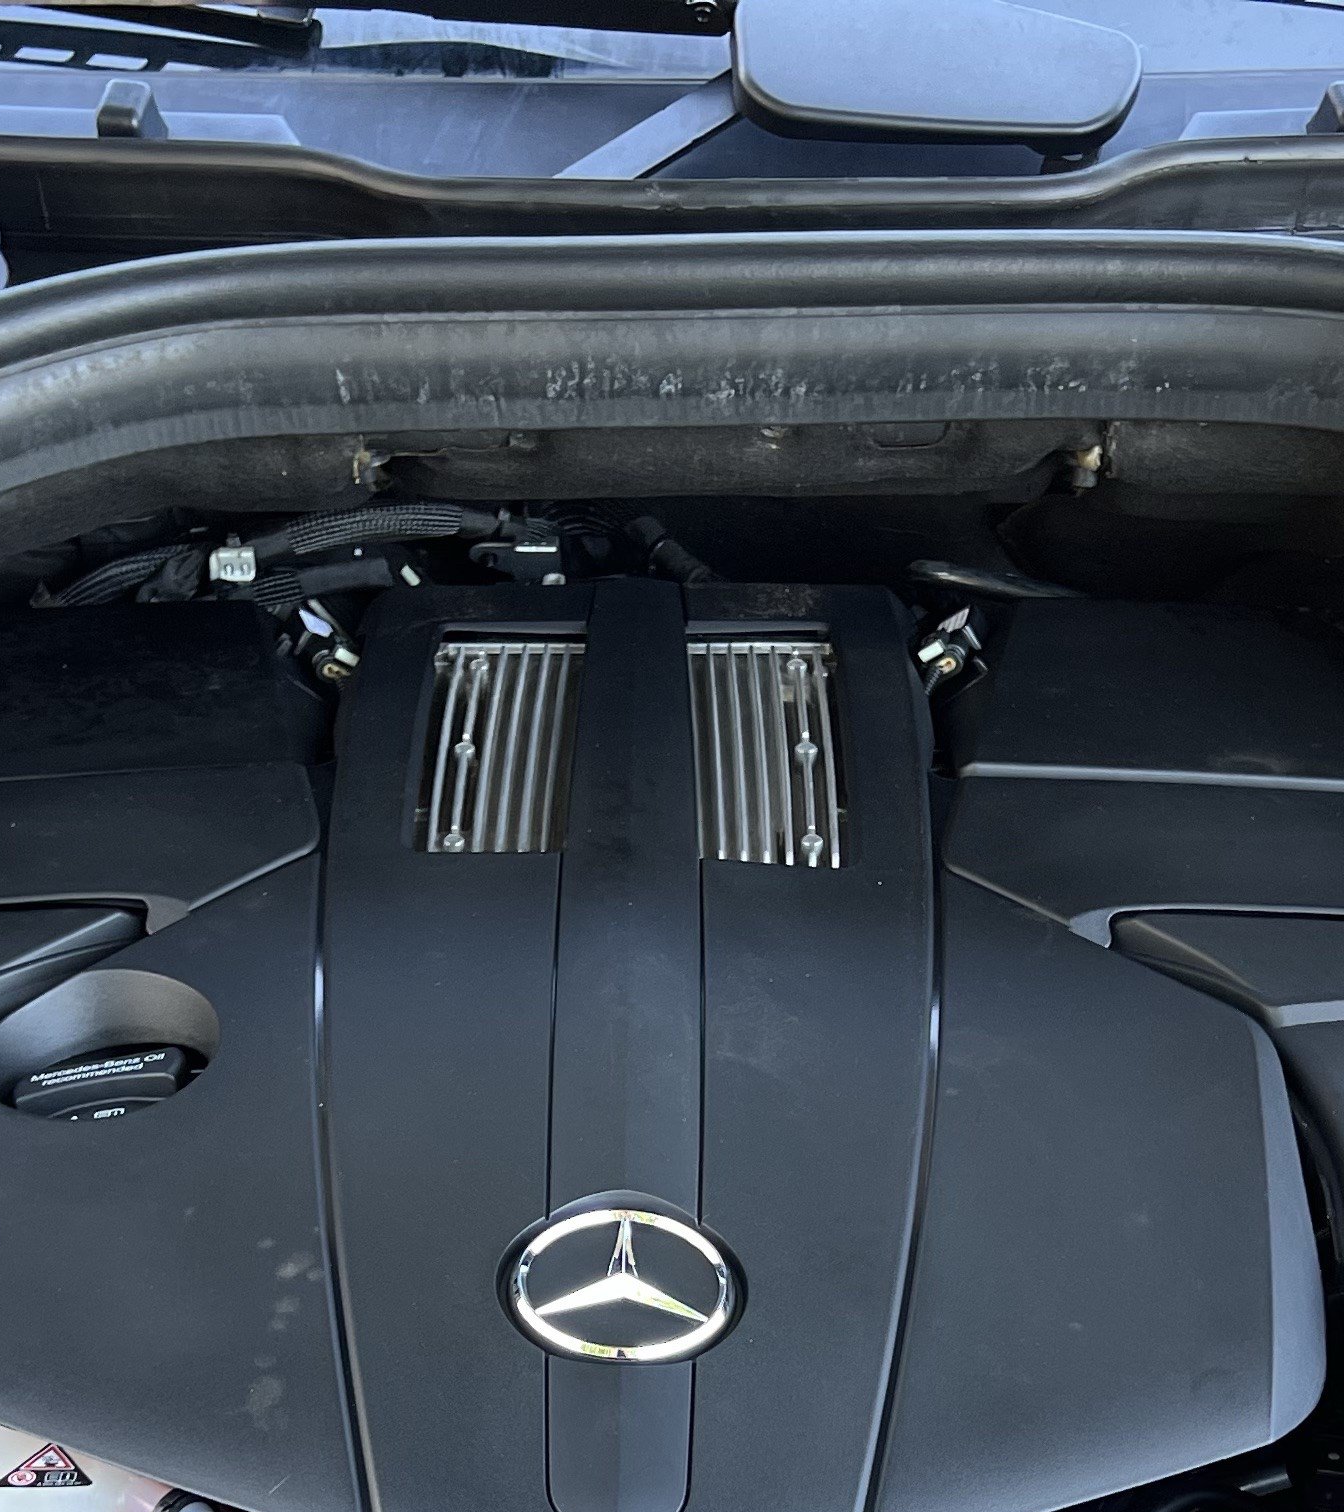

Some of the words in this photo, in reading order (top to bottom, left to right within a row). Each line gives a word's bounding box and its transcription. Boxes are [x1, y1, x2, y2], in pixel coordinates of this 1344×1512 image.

[31, 1057, 141, 1083] Mercedes-Benz
[144, 1053, 166, 1063] Oil
[42, 1062, 144, 1086] recommended
